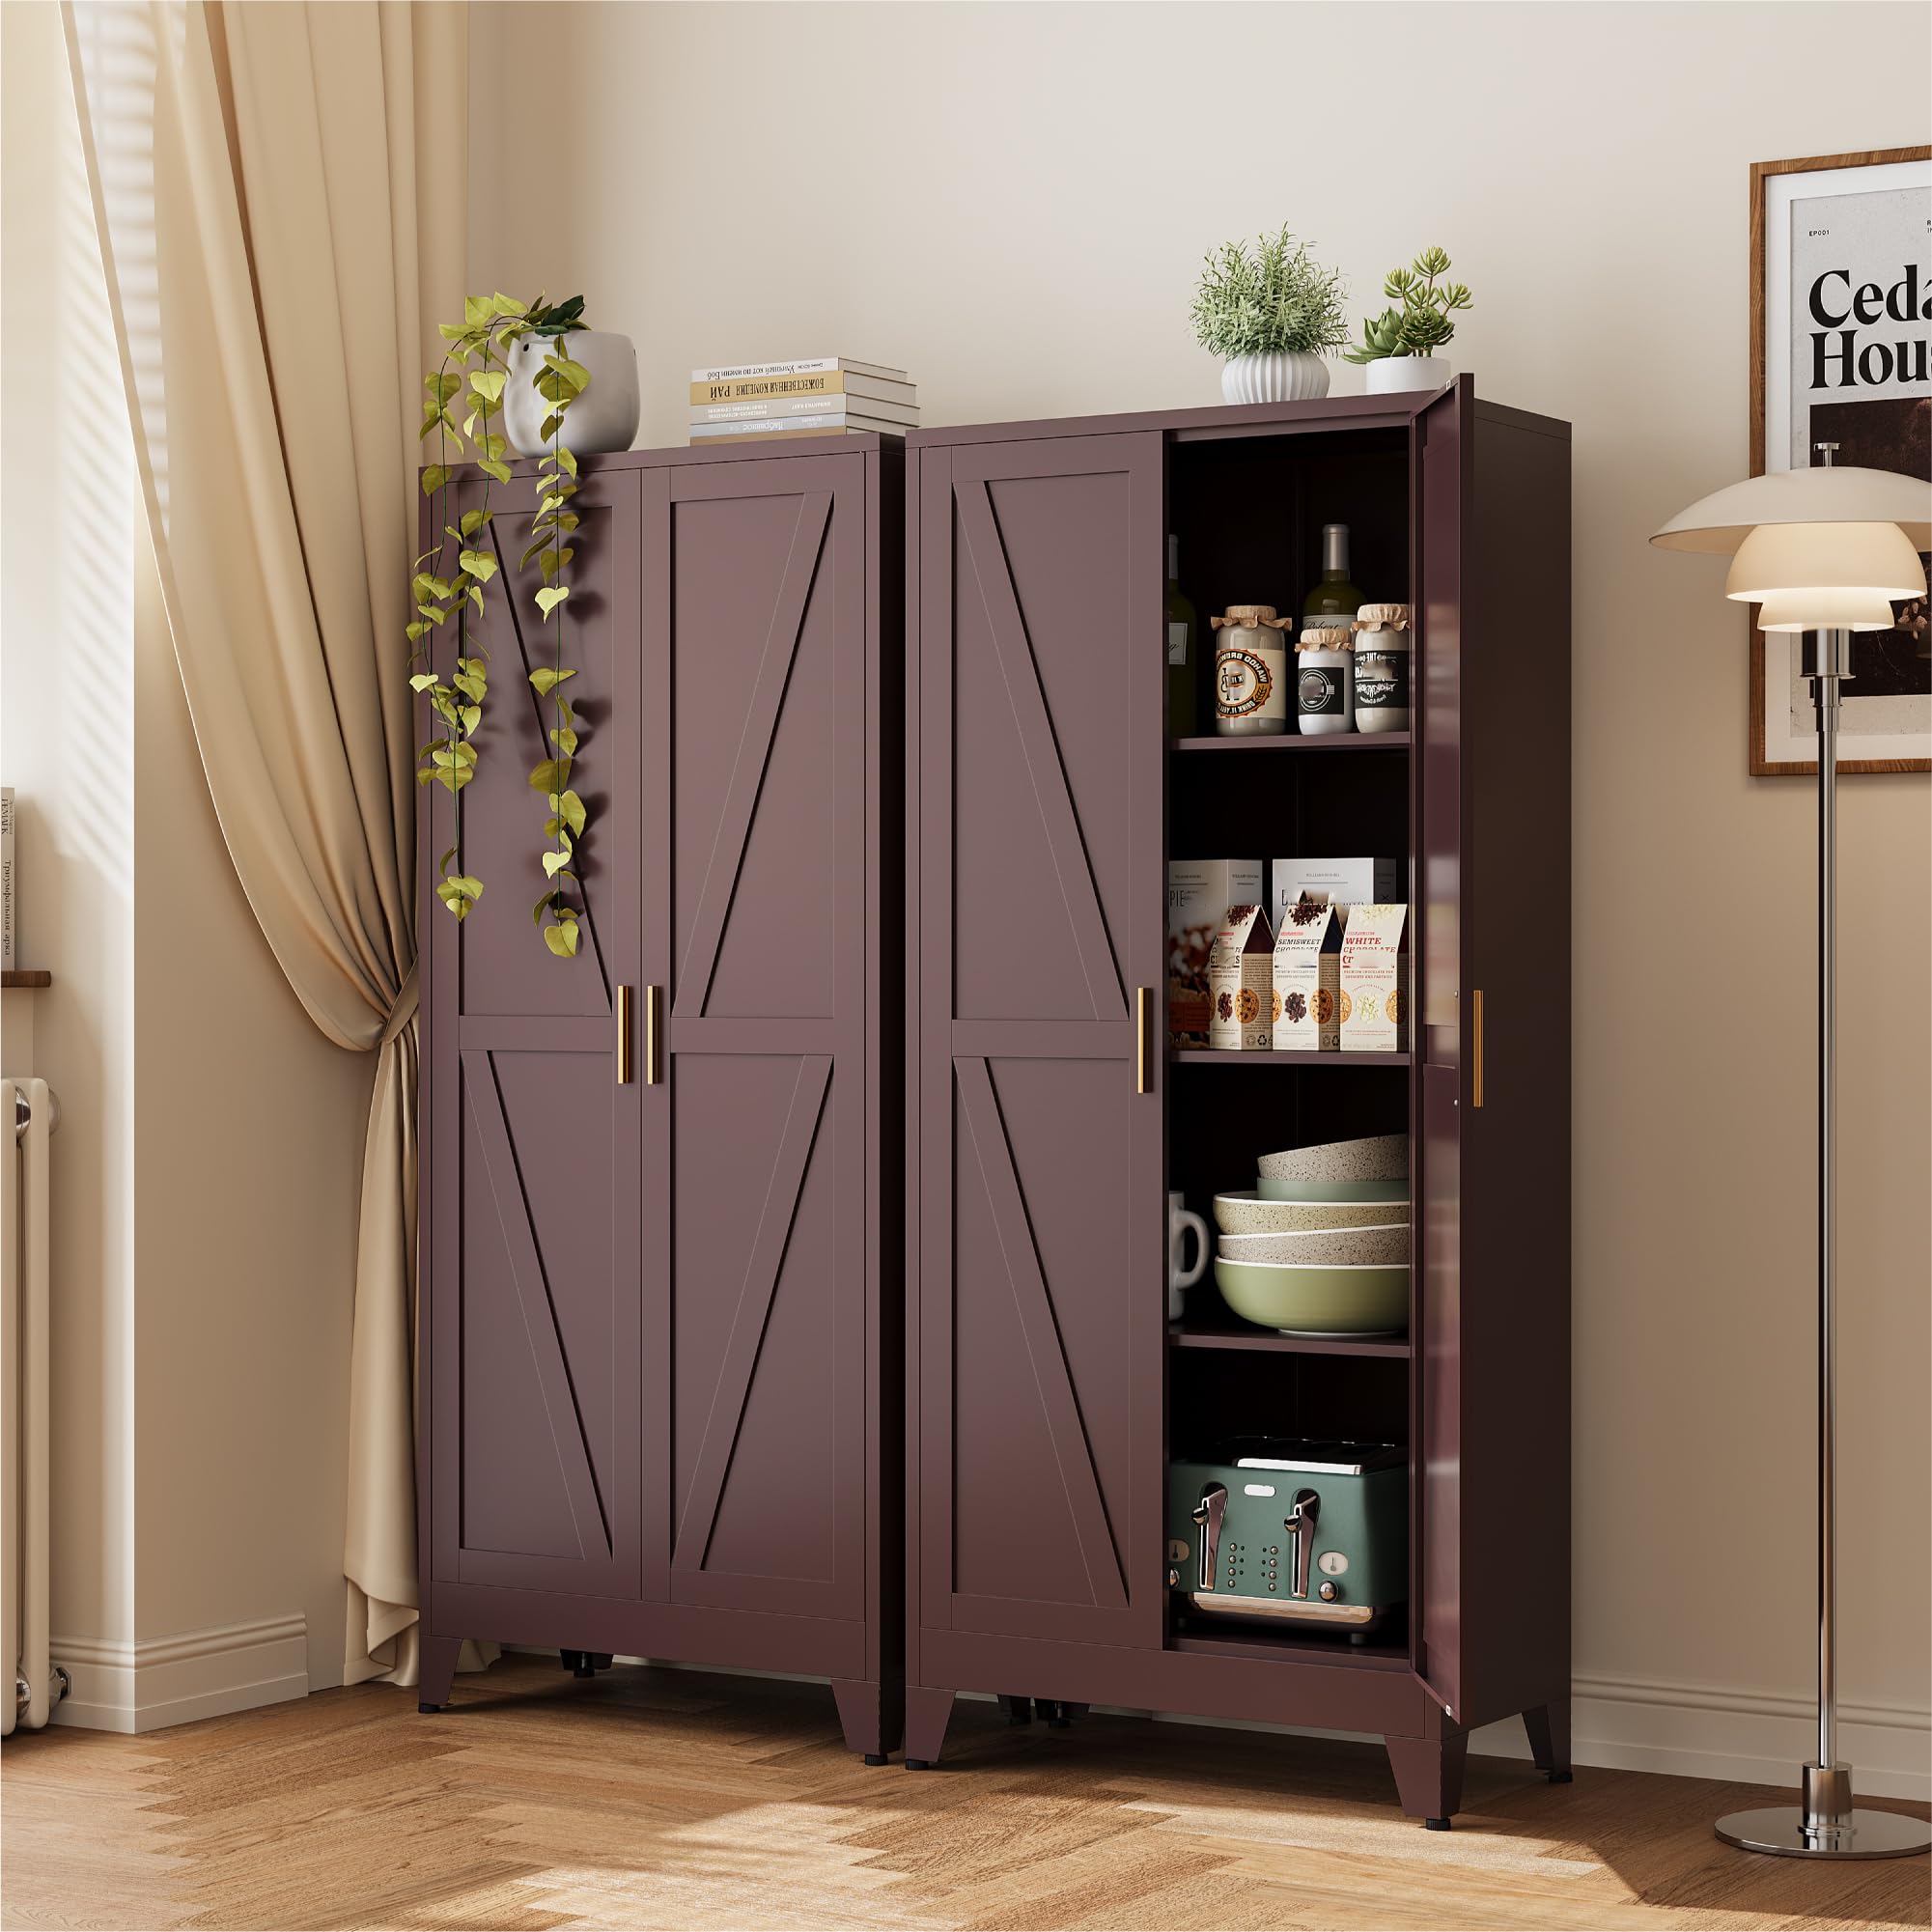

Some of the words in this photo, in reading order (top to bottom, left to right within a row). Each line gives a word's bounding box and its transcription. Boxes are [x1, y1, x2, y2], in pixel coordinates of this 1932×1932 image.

[1808, 329, 1932, 389] Hou
[708, 371, 720, 380] Боб
[736, 382, 769, 396] КОМЕДИЯ
[770, 378, 825, 393] БОЖЕСТВЕННАЯ
[710, 385, 730, 402] РАЙ
[1345, 937, 1383, 945] WHITE
